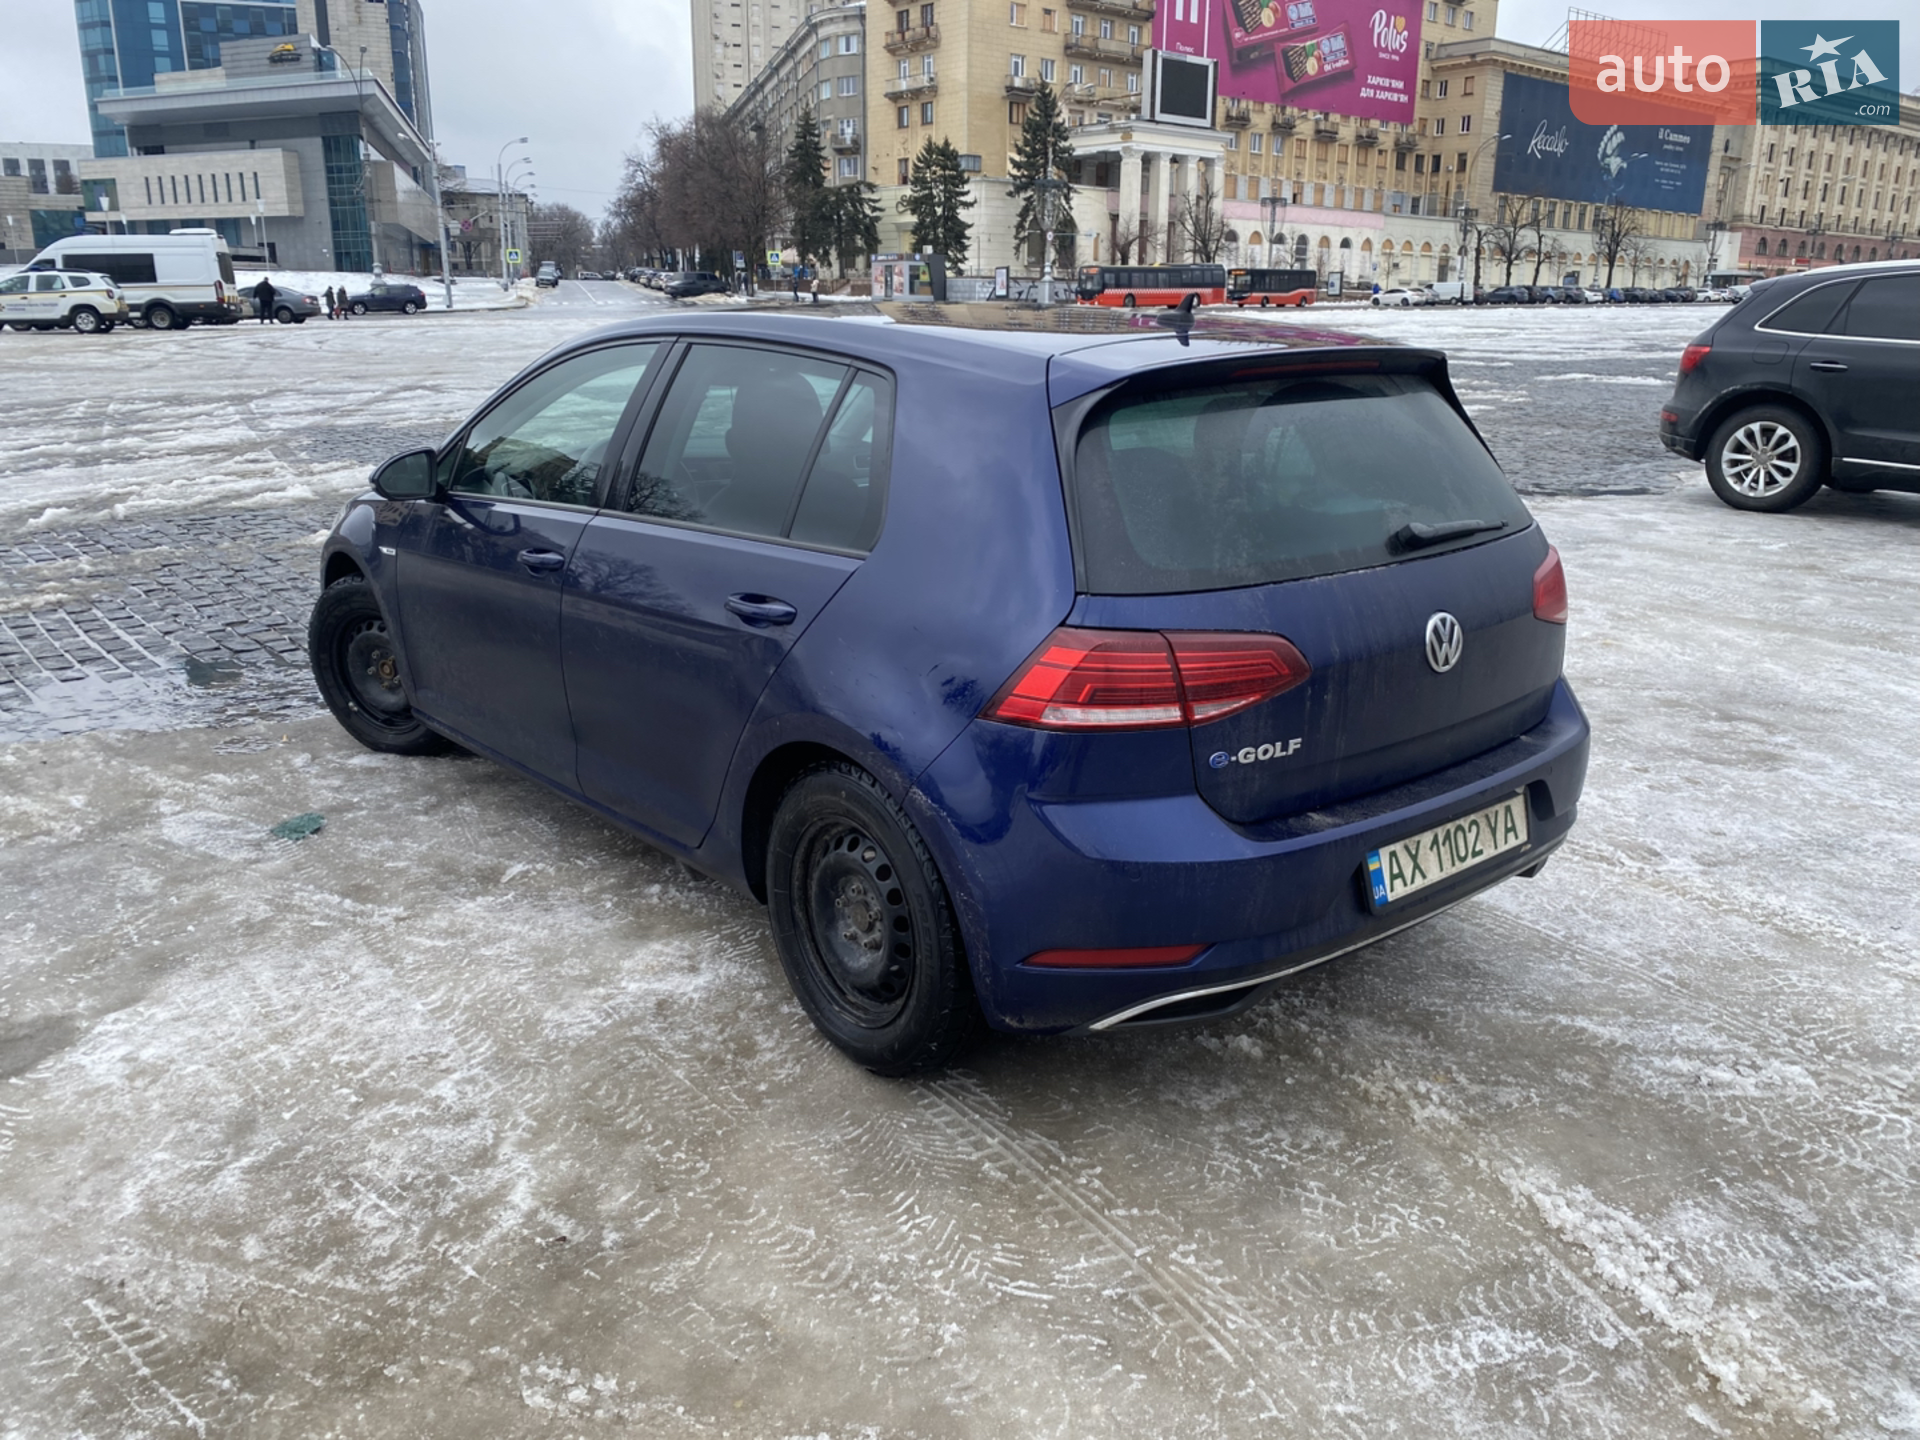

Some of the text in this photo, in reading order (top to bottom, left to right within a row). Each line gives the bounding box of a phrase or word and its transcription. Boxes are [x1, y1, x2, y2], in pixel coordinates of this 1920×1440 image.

[1369, 9, 1408, 53] Polus
[1359, 87, 1374, 98] ДЛЯ
[1388, 804, 1519, 893] AX 1102 YA
[1373, 883, 1387, 900] UA
